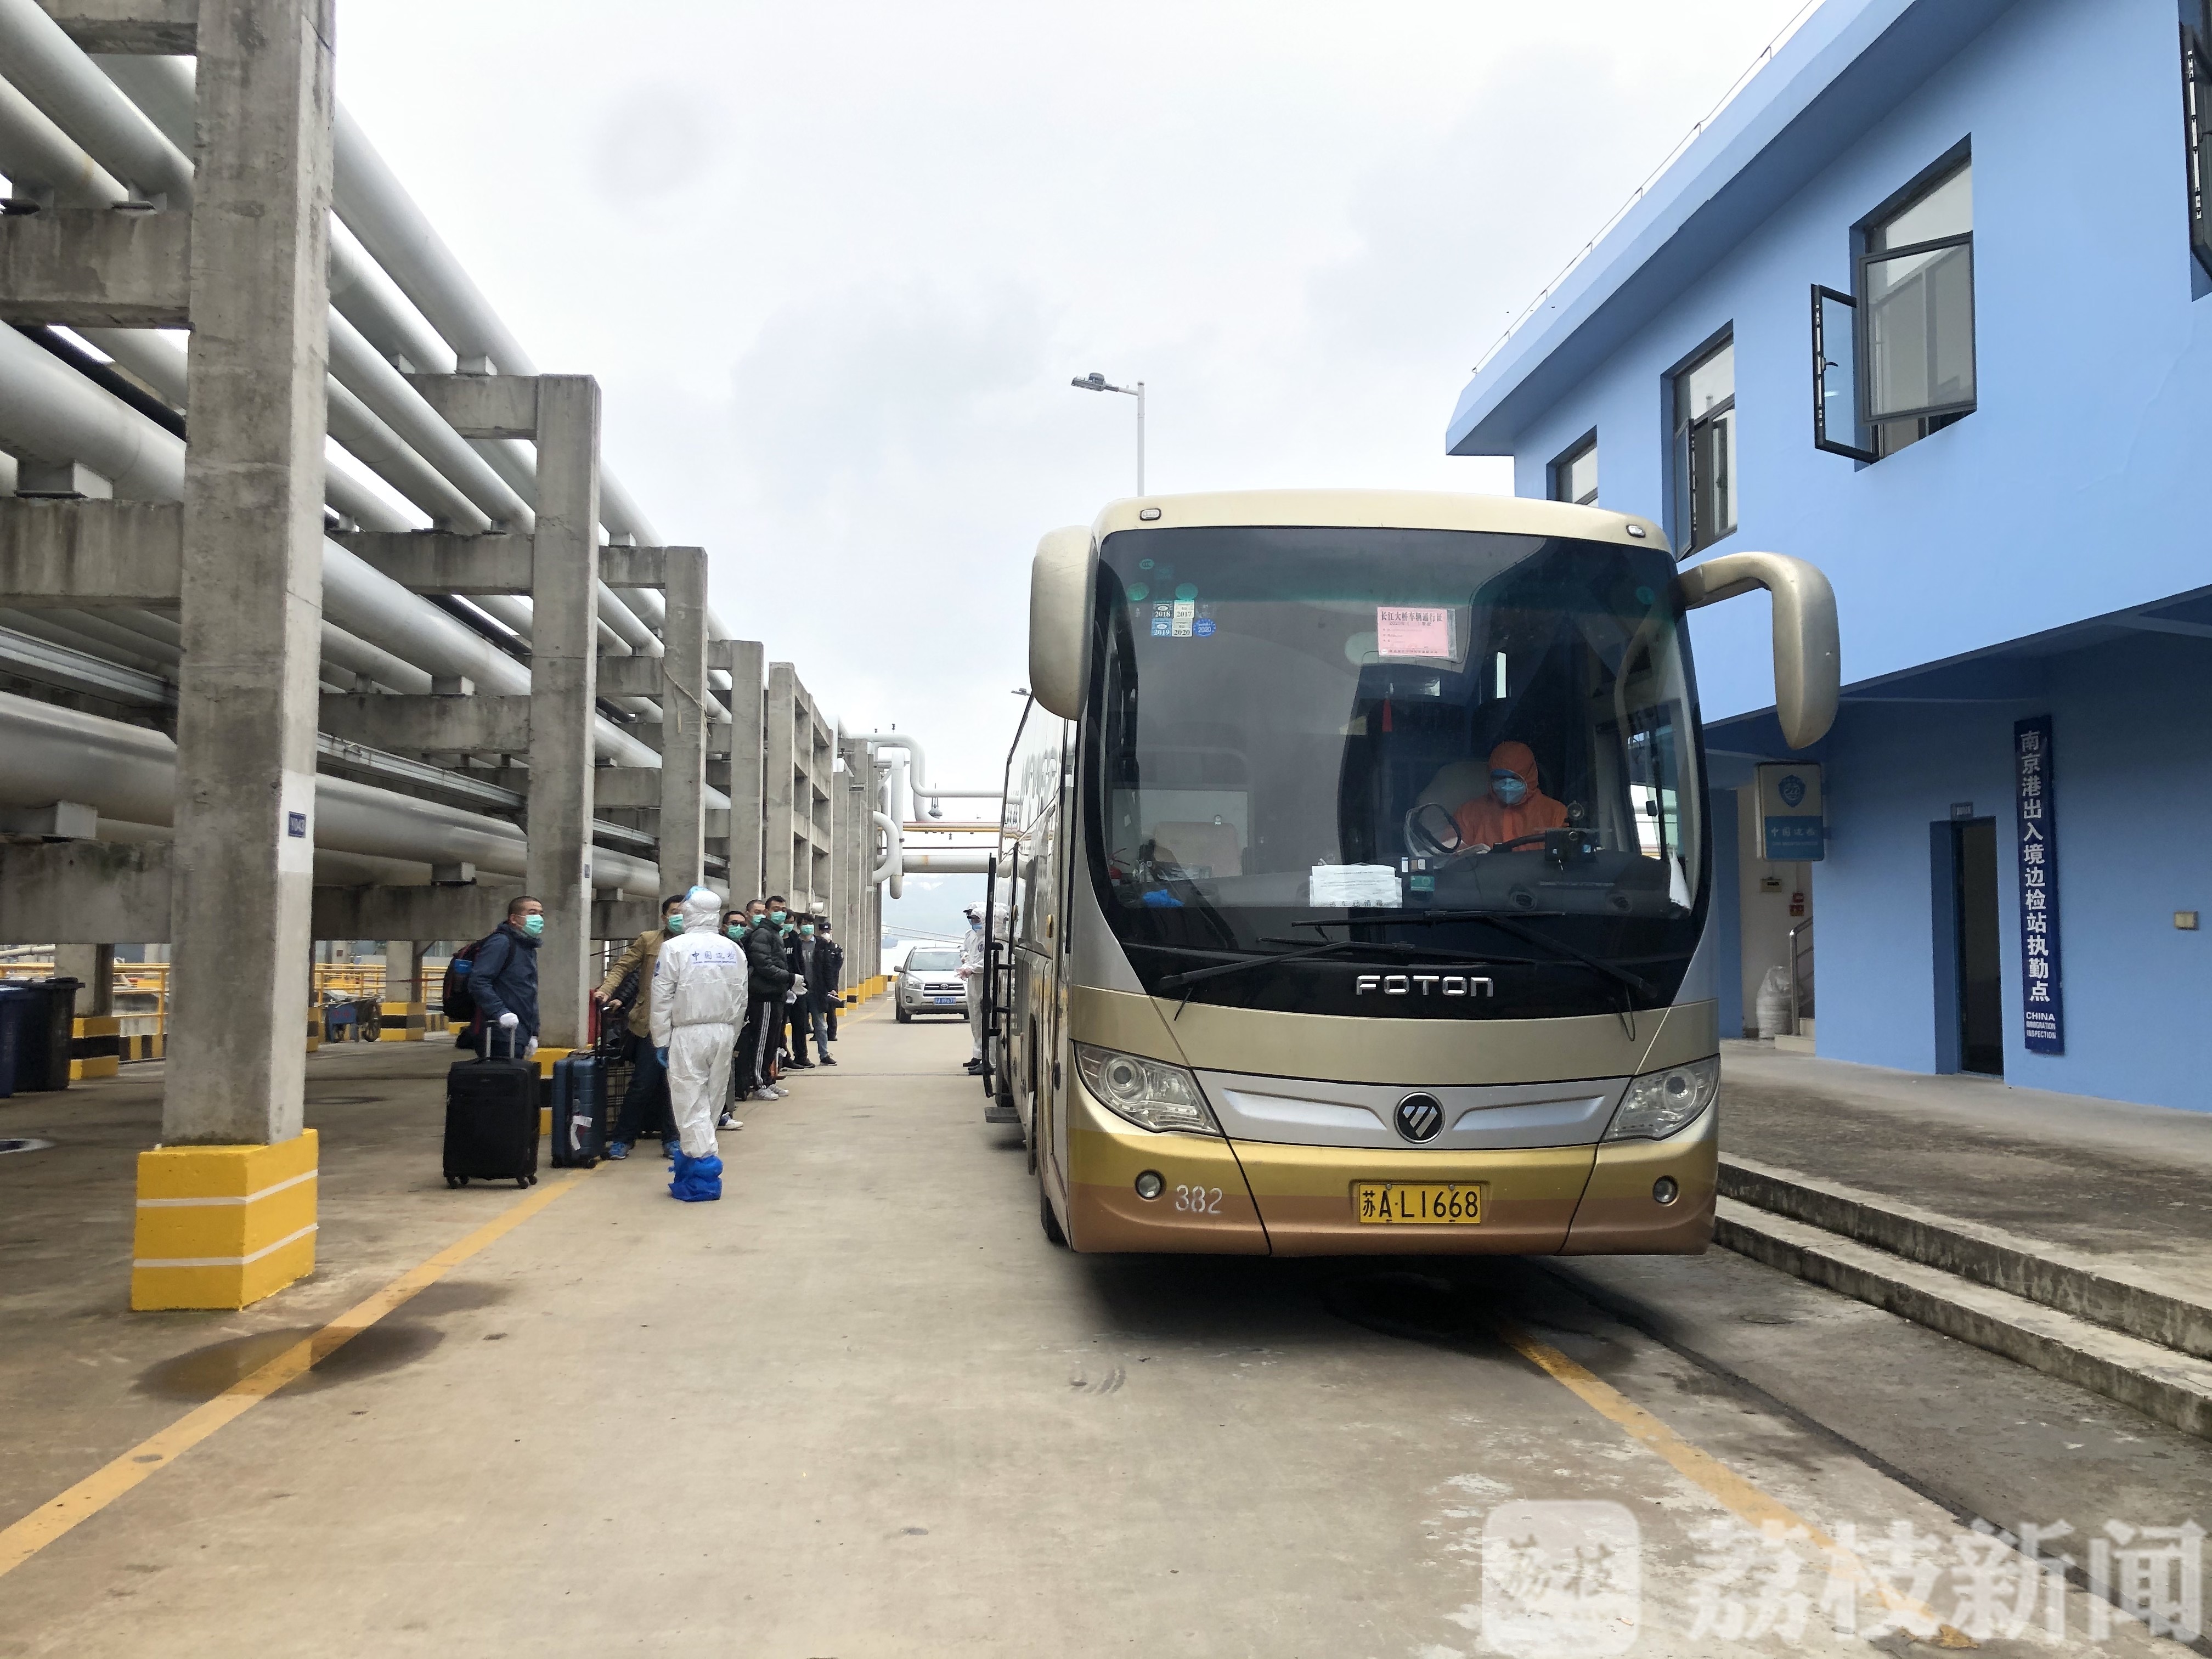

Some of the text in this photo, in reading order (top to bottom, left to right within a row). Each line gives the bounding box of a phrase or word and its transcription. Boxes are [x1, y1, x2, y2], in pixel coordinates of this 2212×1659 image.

[1381, 611, 1443, 622] 长江大桥车辆通行证
[2020, 730, 2050, 1002] 南京港出入境边检站执勤点
[1356, 975, 1493, 997] FOTON
[2026, 1012, 2055, 1021] CHINA
[2026, 1020, 2056, 1030] IMMIGRATION
[2027, 1030, 2056, 1039] INSPECTION
[1175, 1184, 1223, 1214] 382
